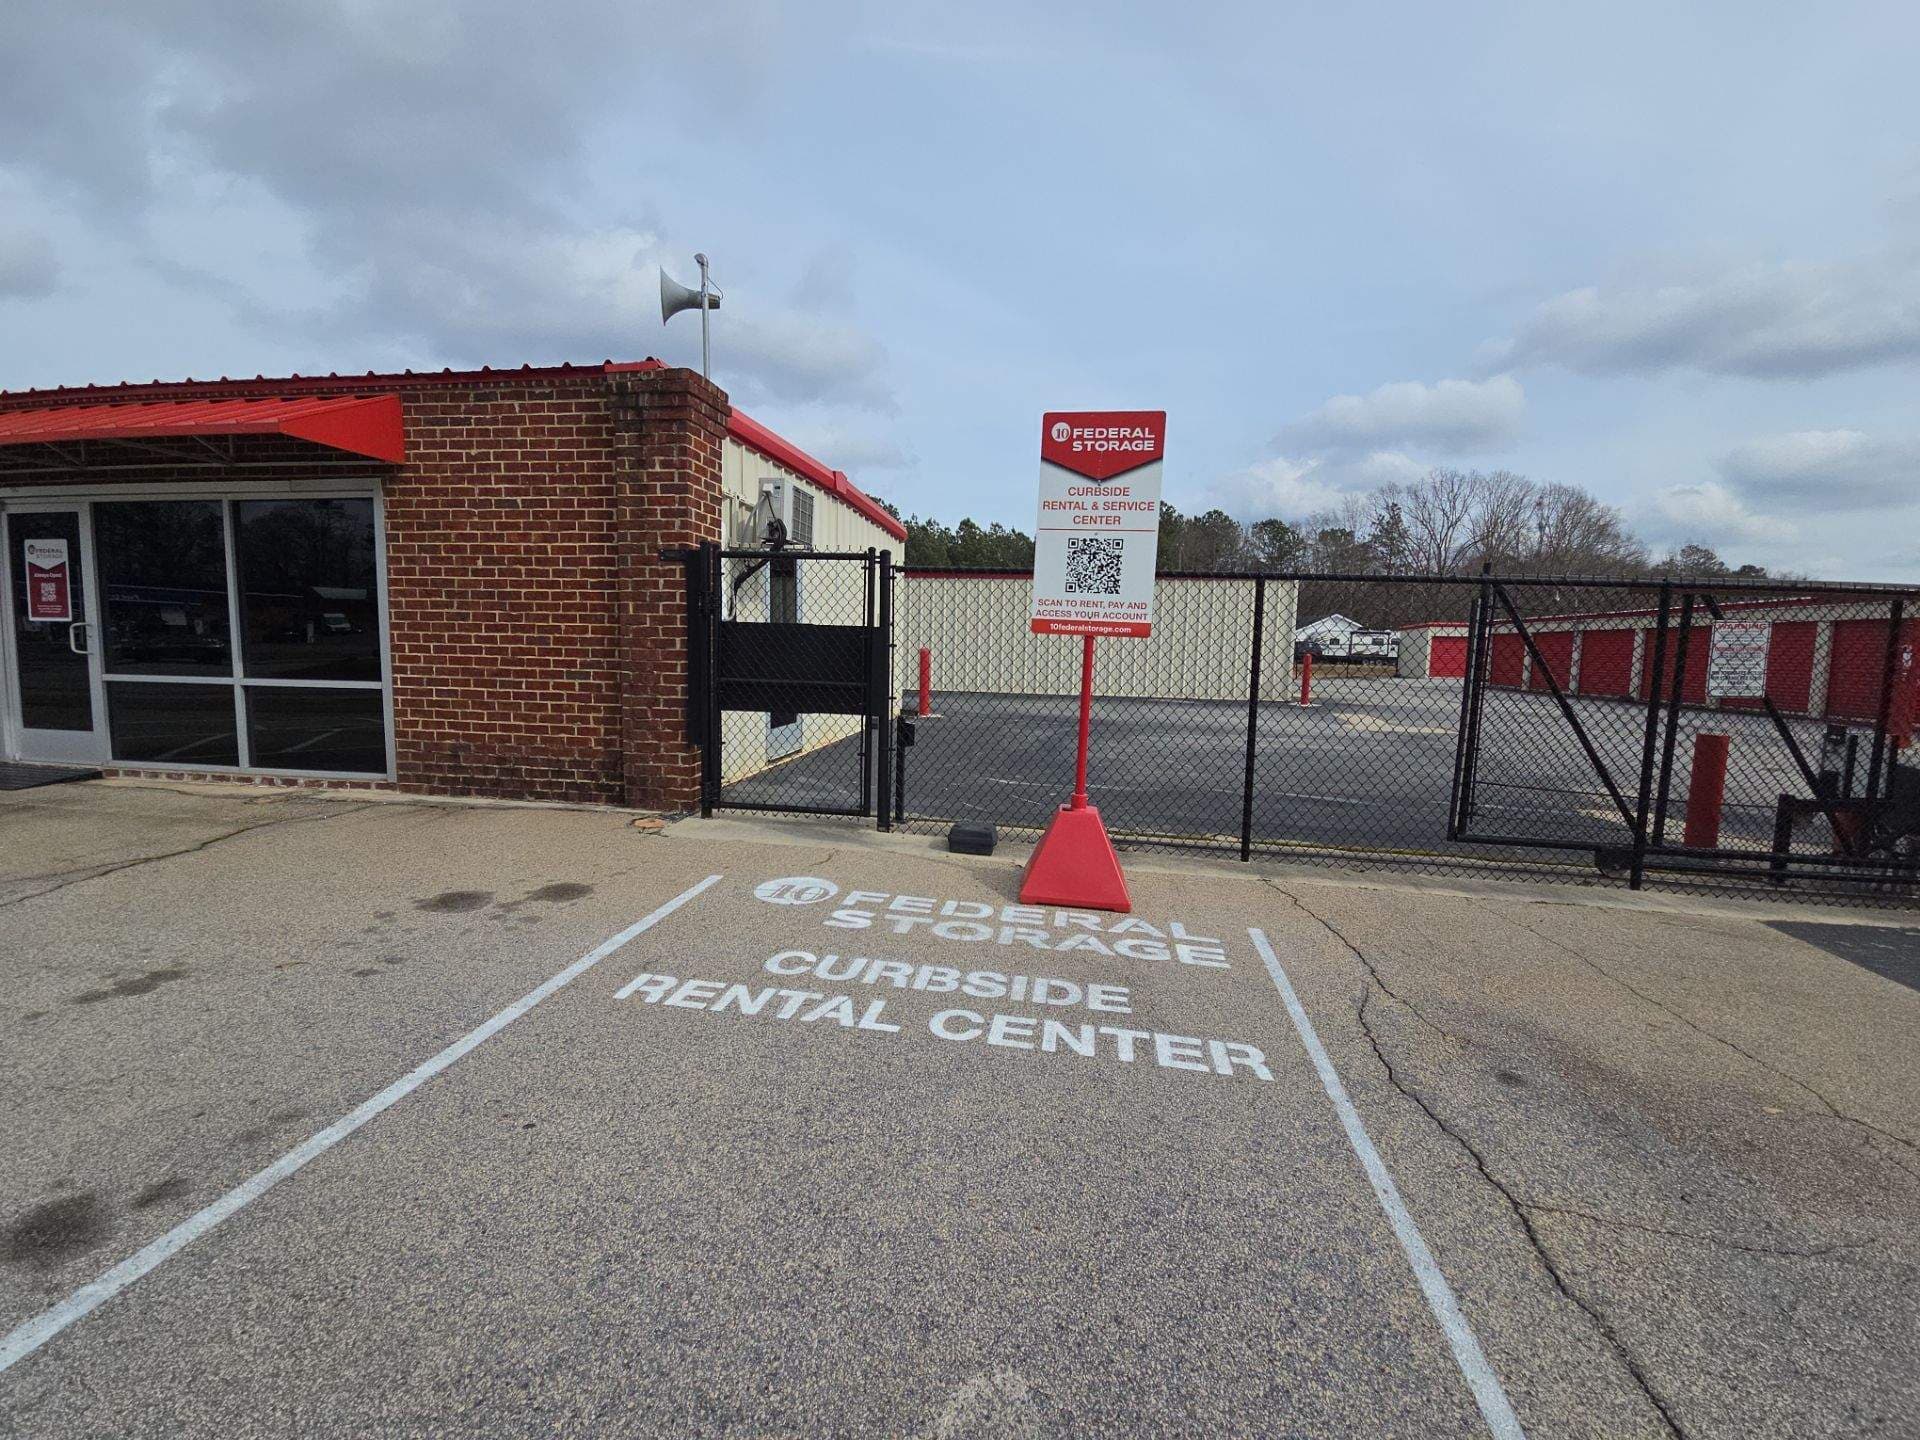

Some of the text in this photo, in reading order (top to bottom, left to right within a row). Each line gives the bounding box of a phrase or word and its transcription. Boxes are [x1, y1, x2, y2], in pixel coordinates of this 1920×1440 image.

[1072, 427, 1155, 439] FEDERAL
[1072, 440, 1155, 452] STORAGE
[1068, 487, 1130, 497] CURBSIDE
[1043, 501, 1155, 511] RENTAL & SERVICE
[1073, 515, 1121, 525] CENTER
[1038, 599, 1062, 607] SCAN
[1066, 600, 1077, 608] TO
[1108, 602, 1124, 610] PAY
[1127, 602, 1147, 610] AND
[1036, 609, 1148, 620] ACCESS YOUR ACCOUNT
[1050, 623, 1131, 633] 10federalstorage.com
[841, 891, 1221, 943] FEDERAL
[822, 910, 1231, 968] STORAGE
[763, 951, 1132, 1013] CURBSIDE
[613, 973, 1274, 1081] RENTAL CENTER
